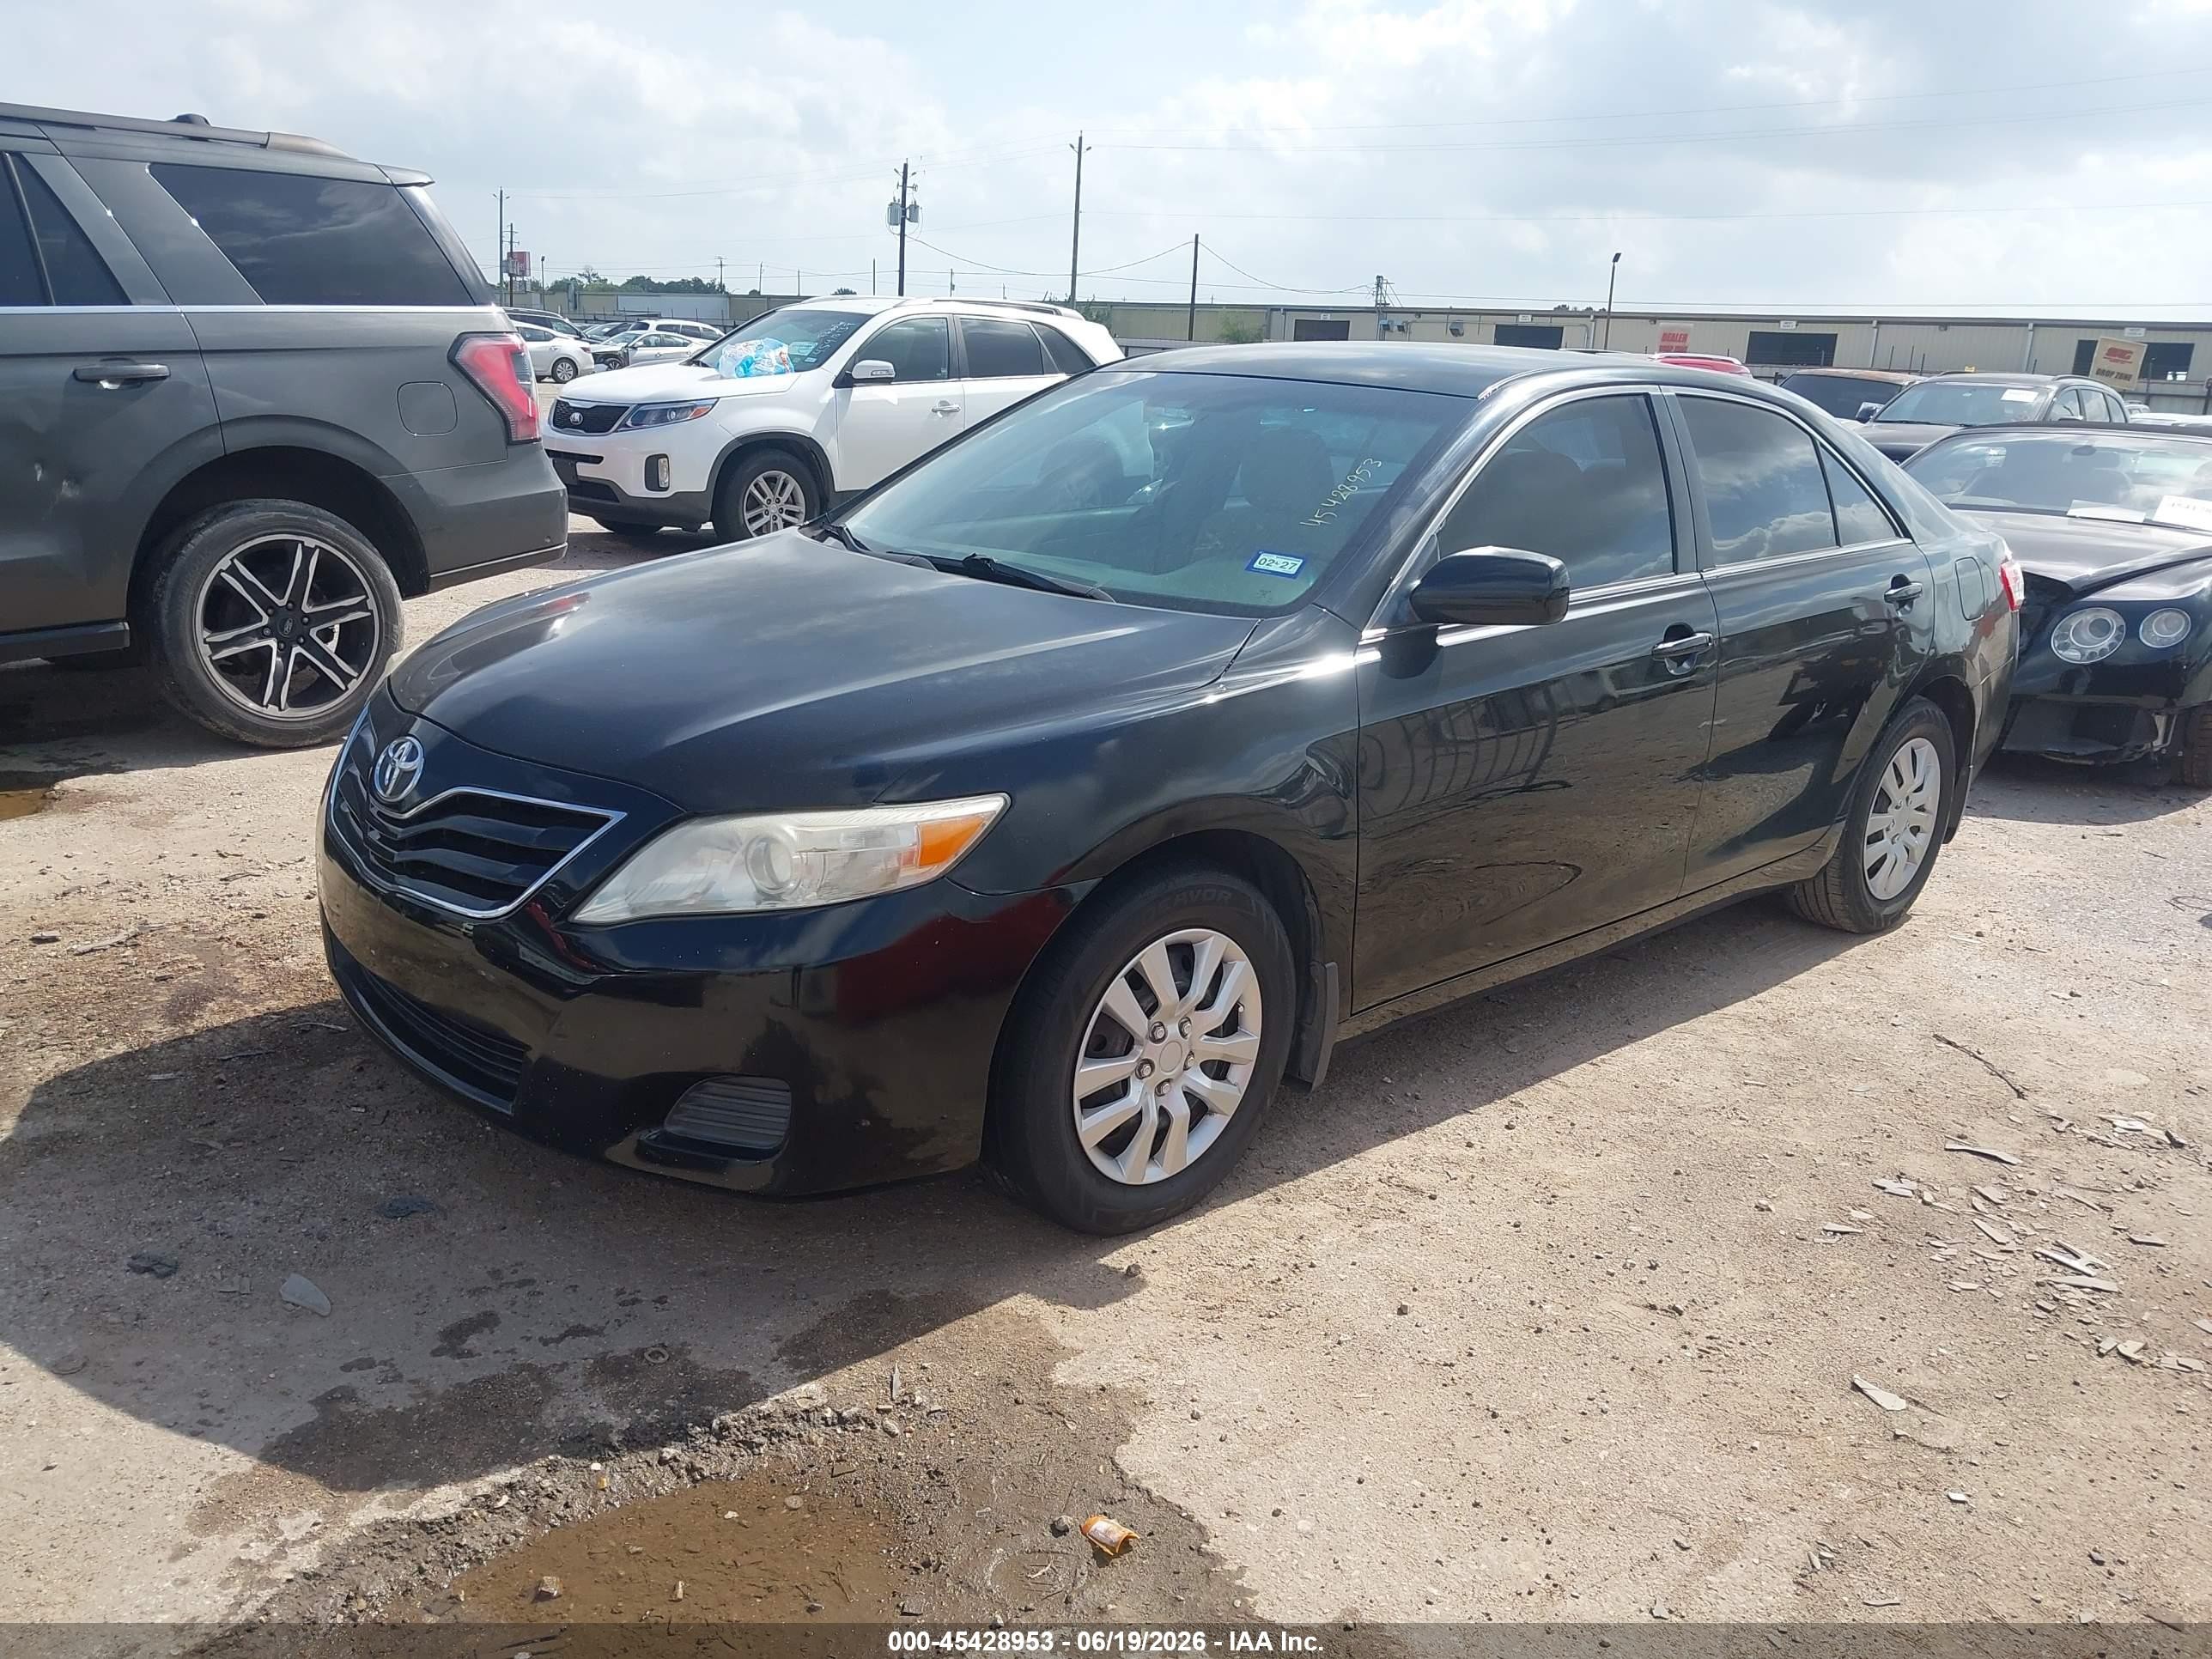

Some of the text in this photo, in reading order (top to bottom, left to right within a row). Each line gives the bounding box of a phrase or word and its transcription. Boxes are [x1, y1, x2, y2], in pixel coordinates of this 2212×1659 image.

[1661, 332, 1688, 342] DEALER
[2095, 368, 2133, 381] DROP ZONE
[1299, 458, 1382, 526] 45428953
[1258, 557, 1276, 568] 02
[1279, 561, 1298, 570] 27
